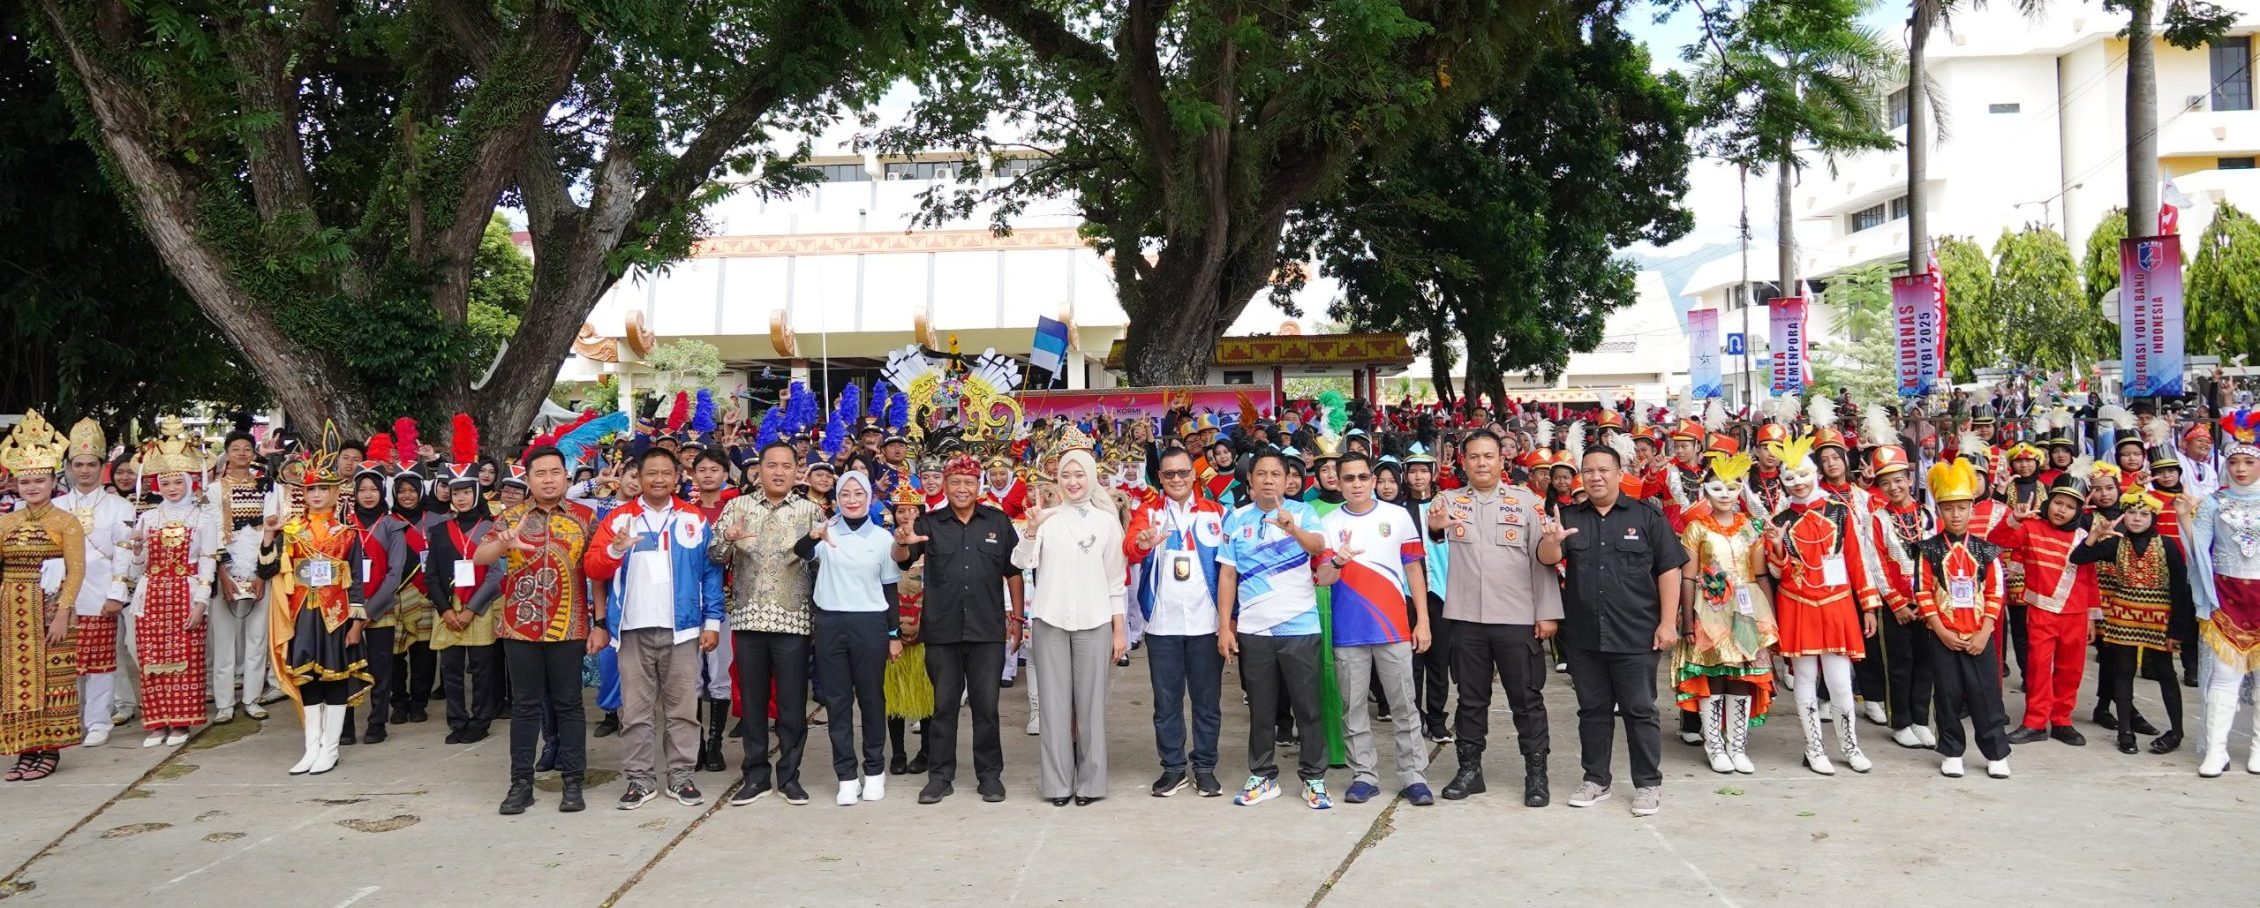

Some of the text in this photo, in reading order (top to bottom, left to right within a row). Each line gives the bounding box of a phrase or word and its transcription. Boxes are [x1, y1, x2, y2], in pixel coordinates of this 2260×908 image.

[1898, 305, 1919, 388] KEJURNAS
[1919, 312, 1933, 375] FYBI 2025
[2134, 273, 2147, 391] FEDERASI YOUTH BAND
[2152, 296, 2164, 353] INDONESIA
[1774, 352, 1786, 390] PIALA
